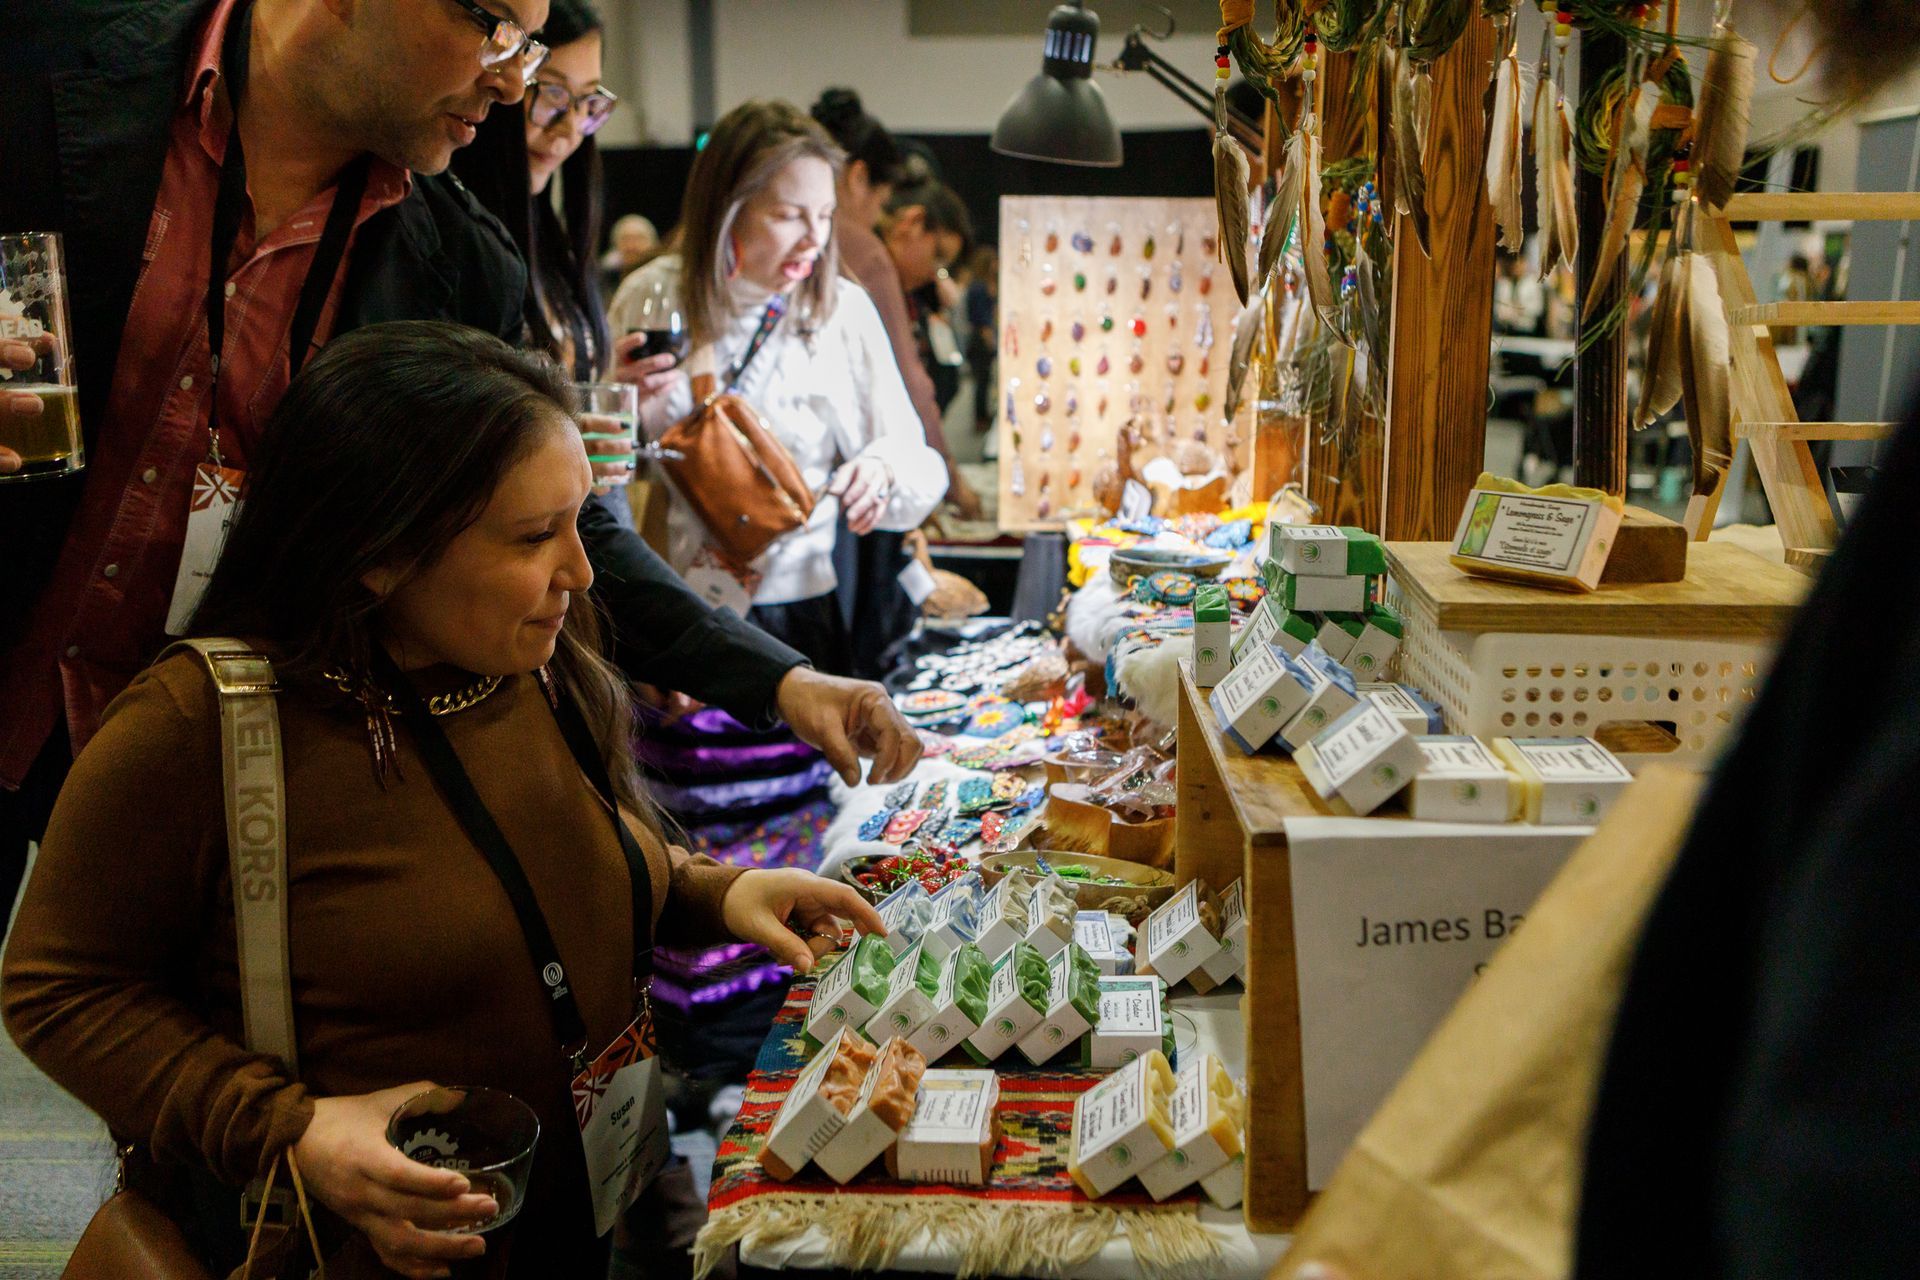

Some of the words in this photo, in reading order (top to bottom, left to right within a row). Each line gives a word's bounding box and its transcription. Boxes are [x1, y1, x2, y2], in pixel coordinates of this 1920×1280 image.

[1505, 506, 1545, 522] Lemongrass
[1554, 512, 1574, 527] Sage
[237, 785, 278, 901] KORS
[1356, 916, 1471, 948] James
[610, 1095, 636, 1126] Susan
